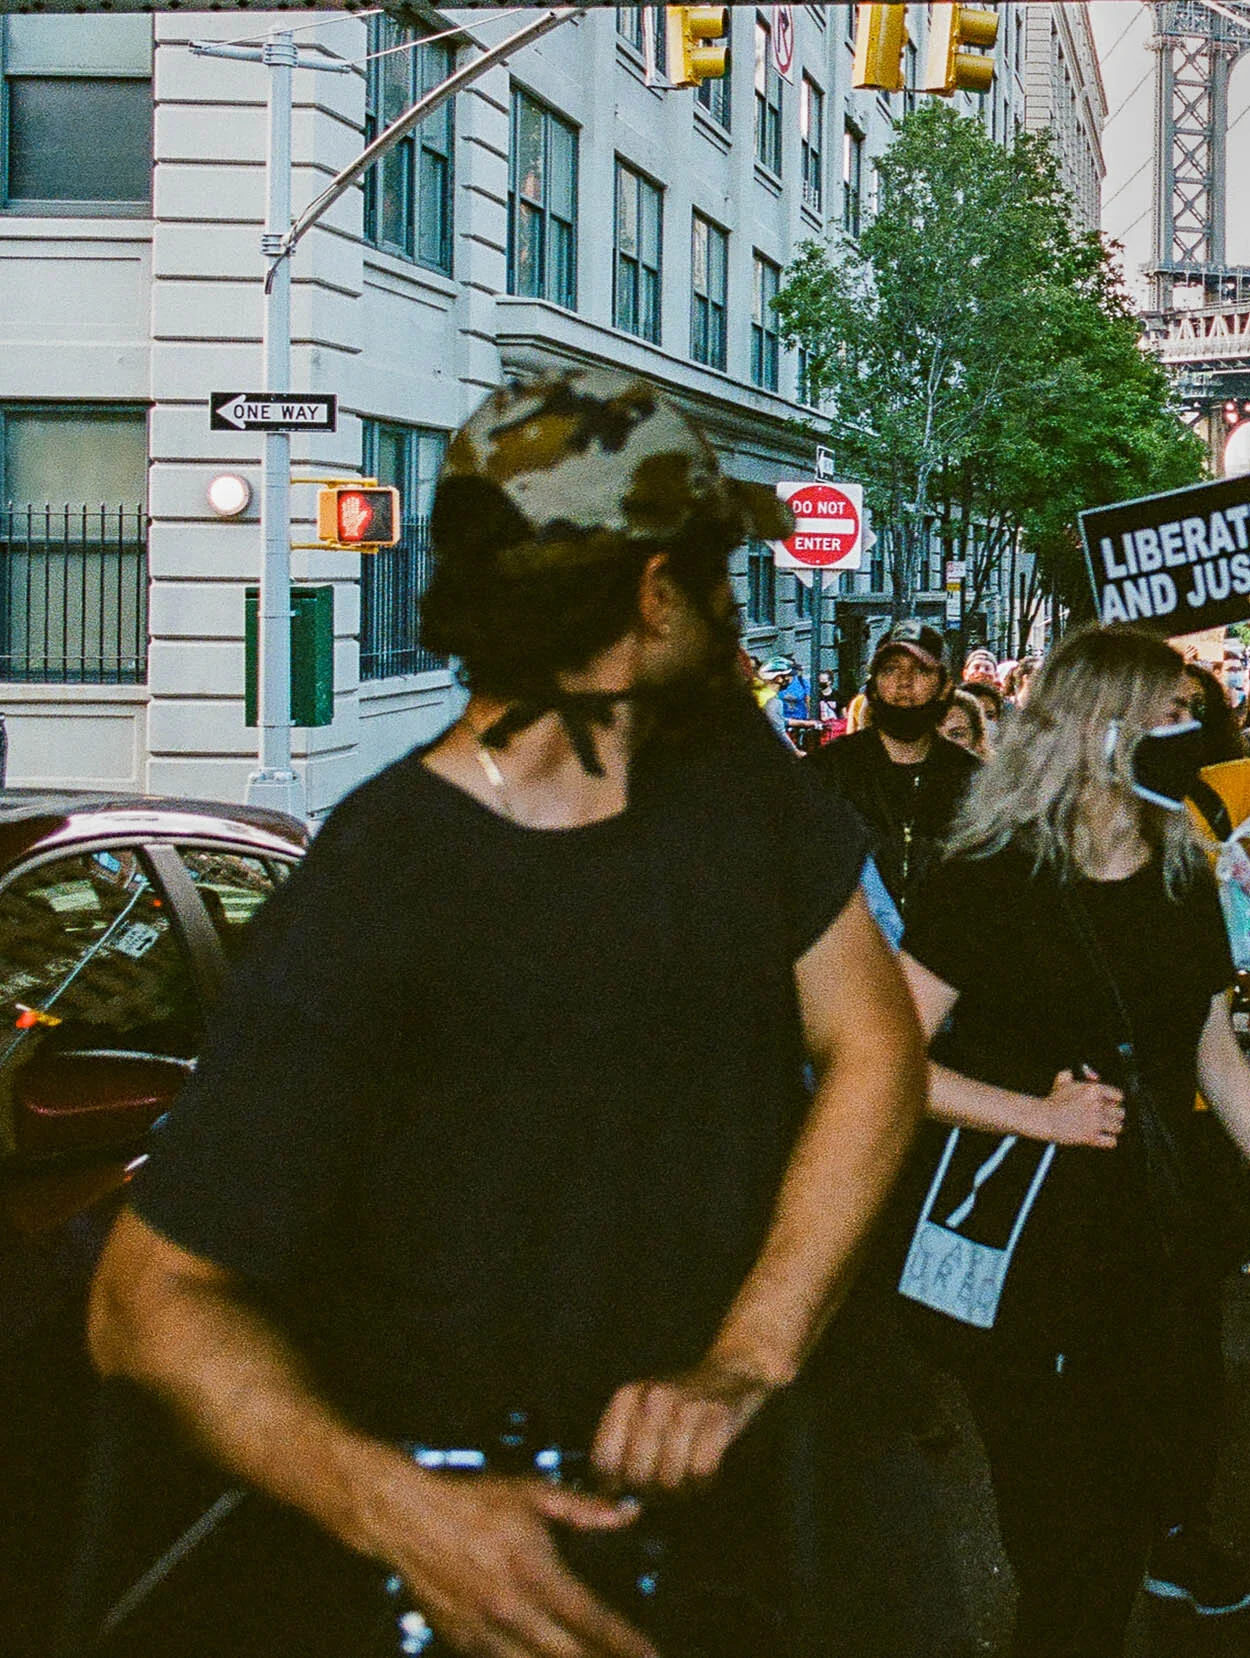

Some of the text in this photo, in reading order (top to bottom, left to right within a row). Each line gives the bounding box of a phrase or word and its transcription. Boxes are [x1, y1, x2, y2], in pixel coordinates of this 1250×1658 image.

[233, 404, 319, 420] ONE WAY
[792, 501, 846, 515] DO NOT
[795, 537, 842, 551] ENTER
[1101, 572, 1178, 626] AND
